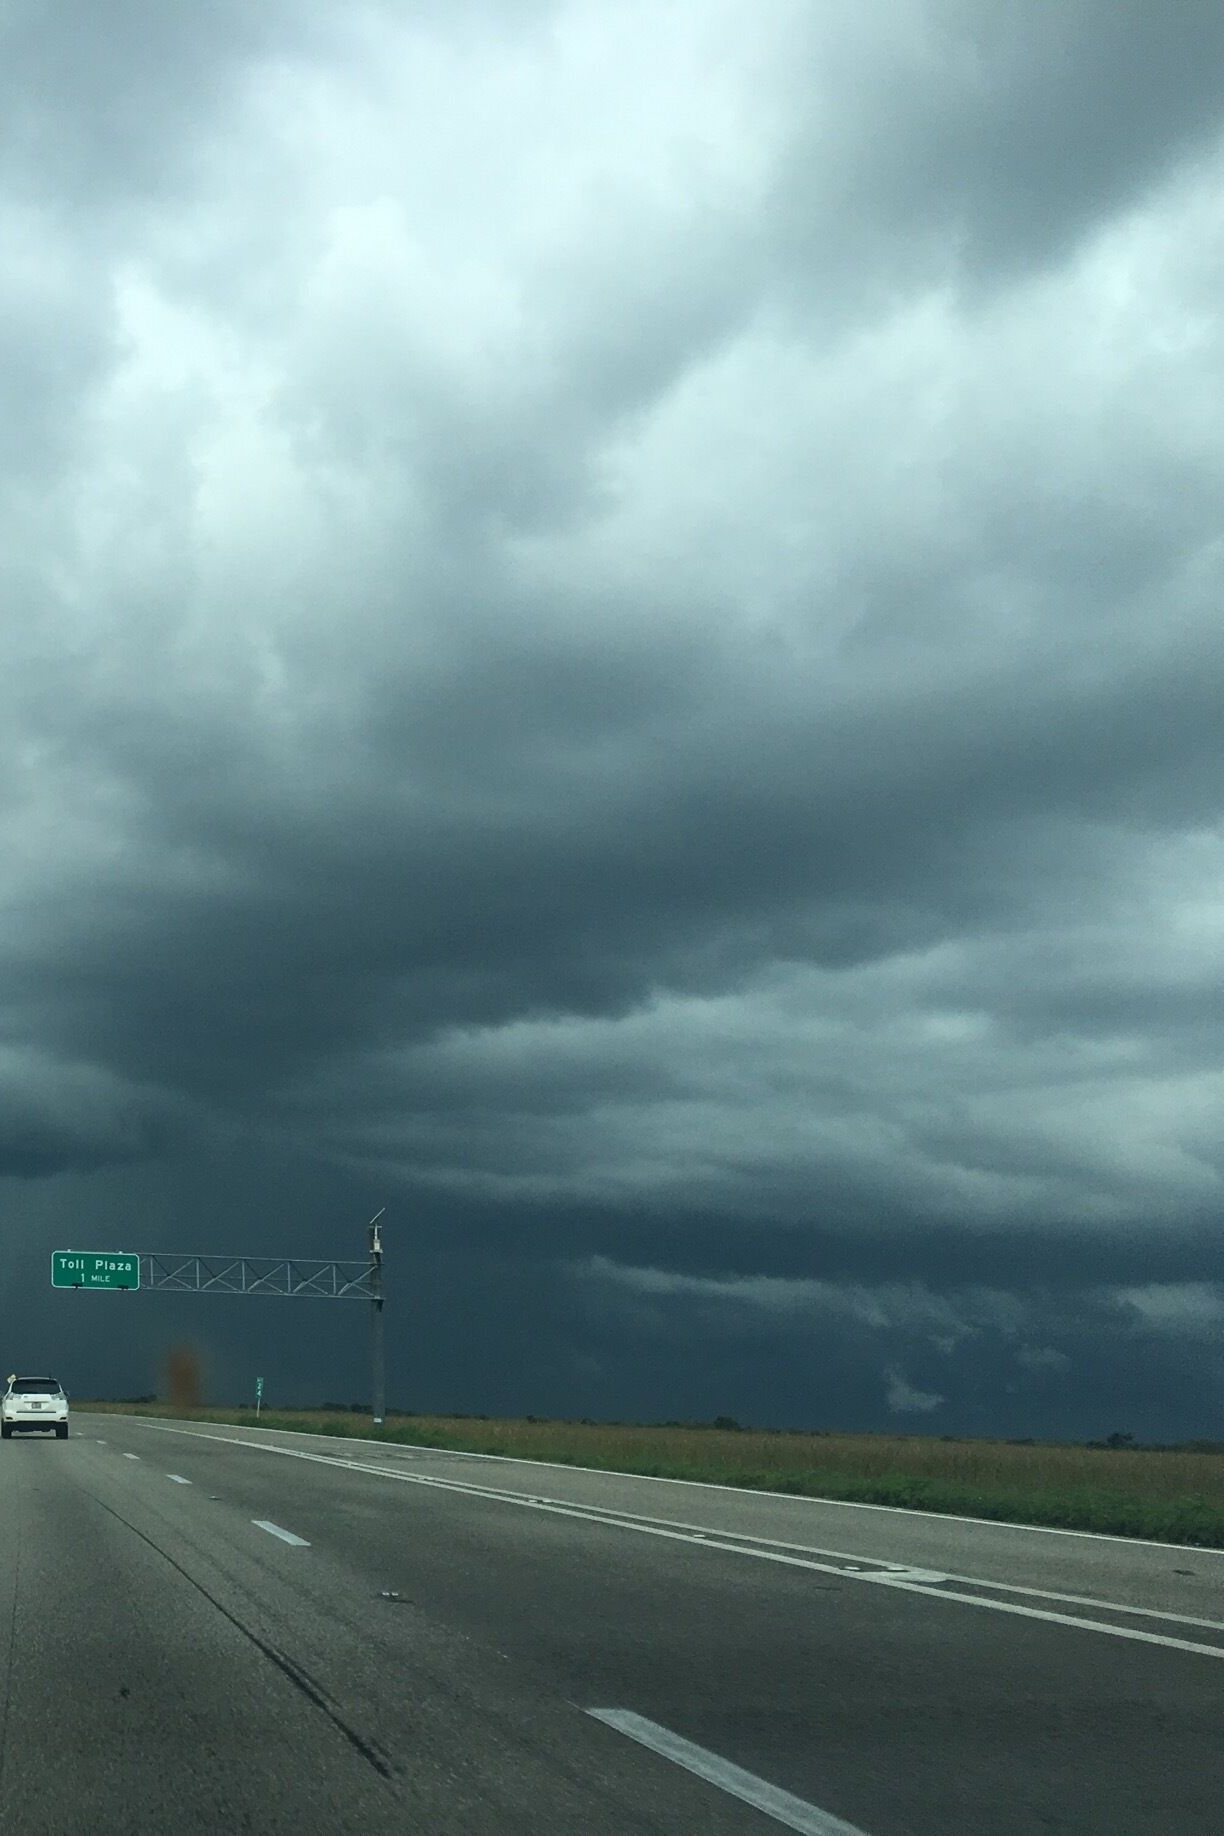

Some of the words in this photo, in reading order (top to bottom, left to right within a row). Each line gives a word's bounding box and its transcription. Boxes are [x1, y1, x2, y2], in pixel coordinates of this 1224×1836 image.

[60, 1258, 84, 1269] Toll
[95, 1260, 132, 1271] Plaza
[81, 1273, 85, 1282] 1
